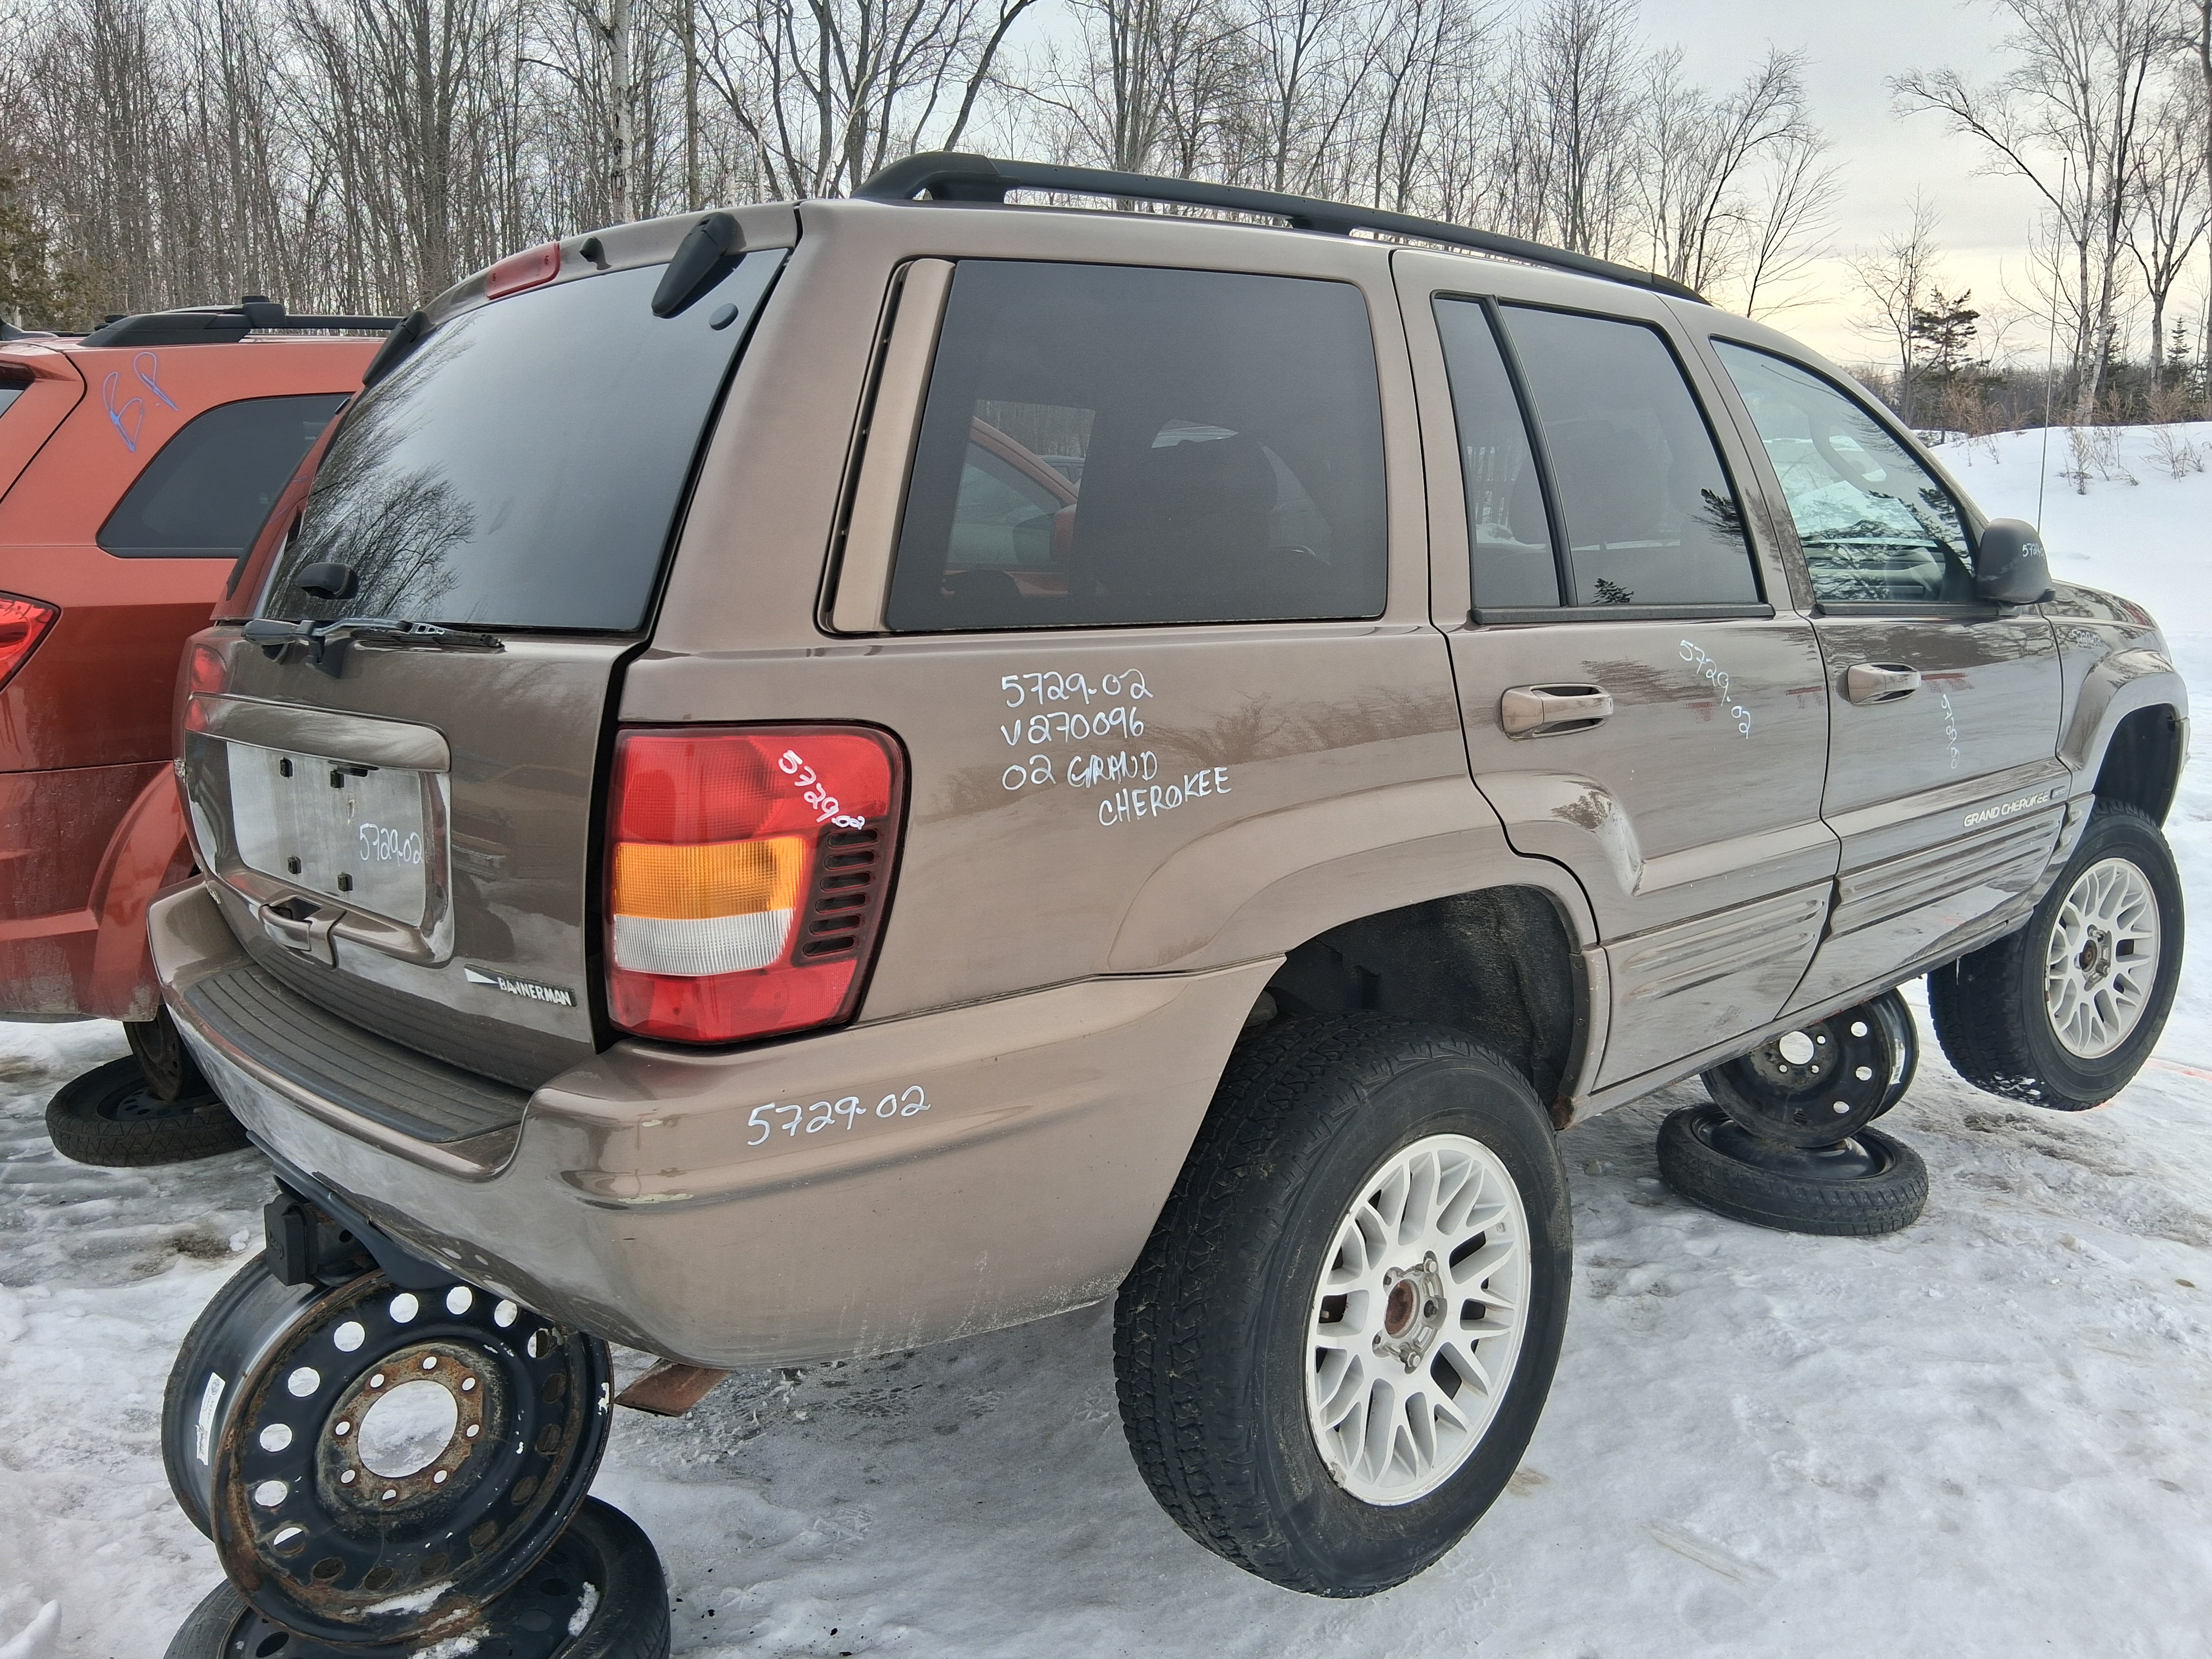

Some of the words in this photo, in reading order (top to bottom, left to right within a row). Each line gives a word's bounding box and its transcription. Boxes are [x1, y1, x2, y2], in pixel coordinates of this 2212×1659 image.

[1001, 753, 1057, 791] 02
[1066, 750, 1159, 788] GRAND
[1098, 766, 1232, 827] CHEROKEE
[1963, 806, 2000, 828] GRAND
[2001, 789, 2049, 815] CHEROKEE
[497, 976, 573, 1007] BANNERMAN
